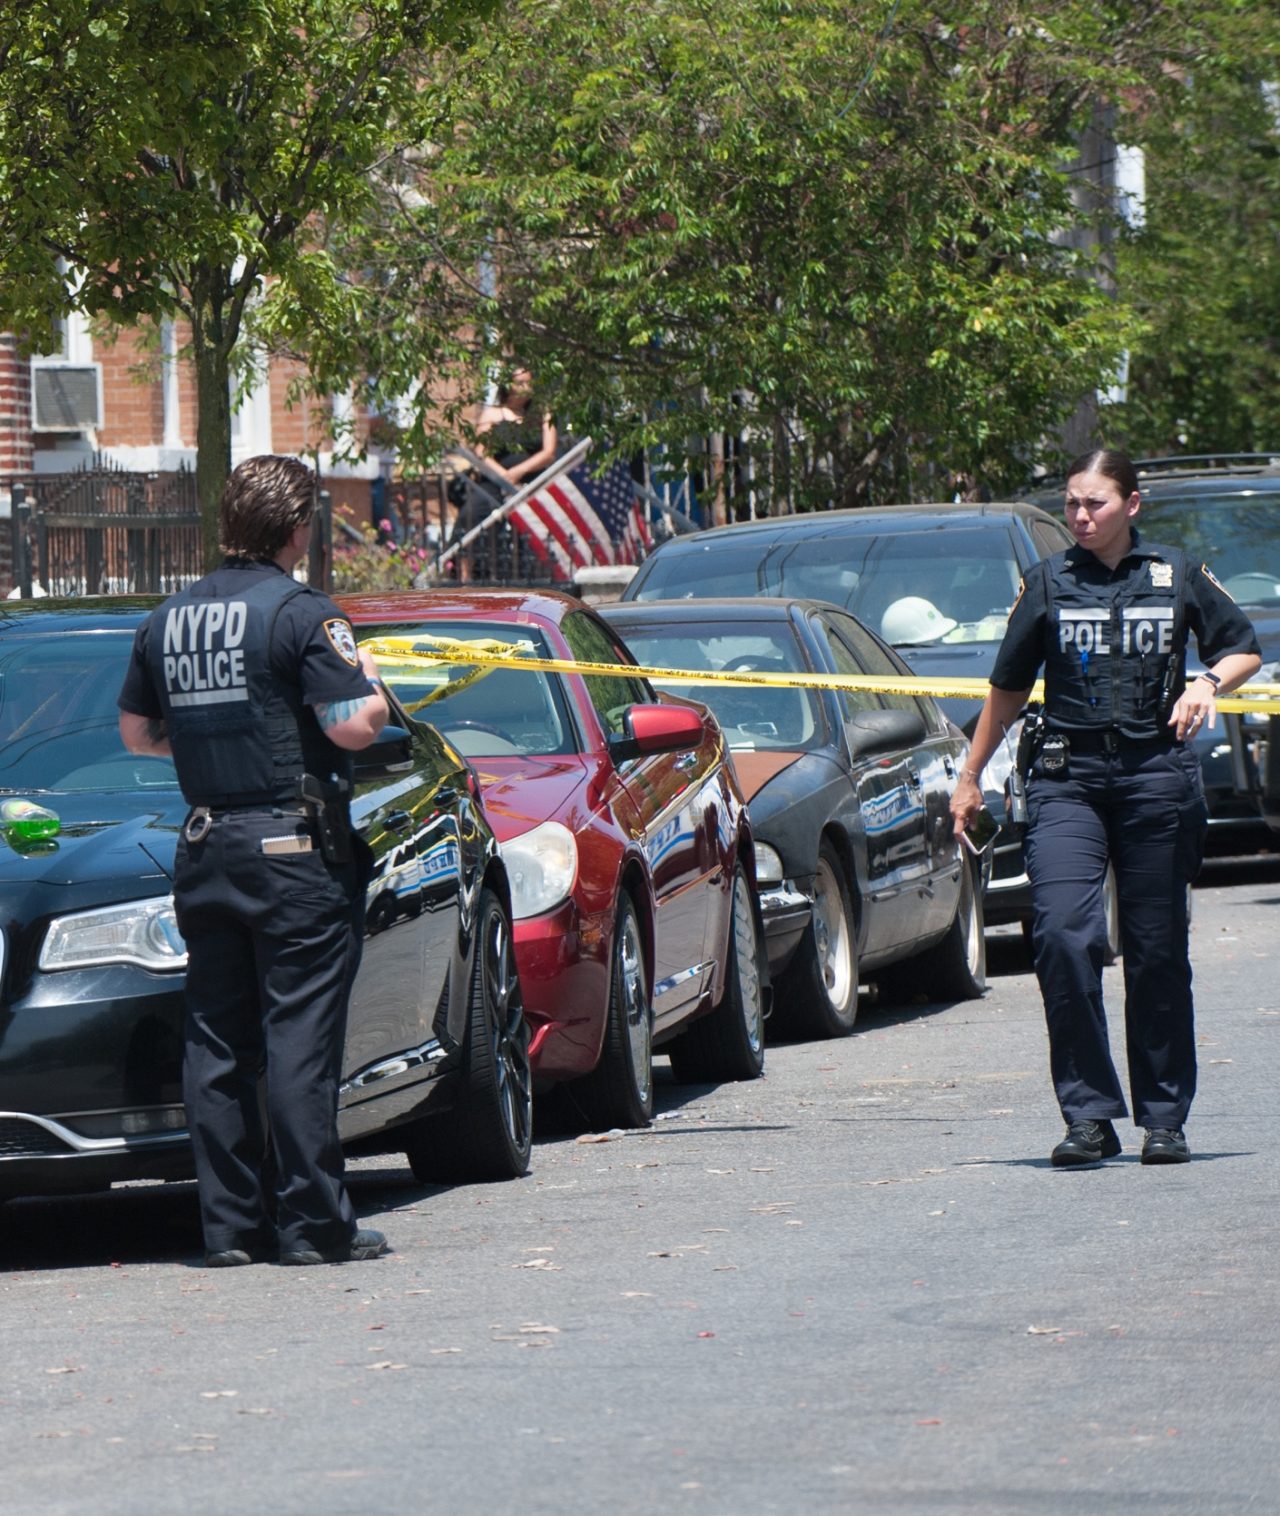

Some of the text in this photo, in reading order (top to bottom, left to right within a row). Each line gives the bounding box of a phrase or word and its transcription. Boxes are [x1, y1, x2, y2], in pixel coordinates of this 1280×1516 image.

[163, 601, 247, 654] NYPD
[1059, 620, 1174, 655] POLICE
[163, 649, 247, 692] POLICE
